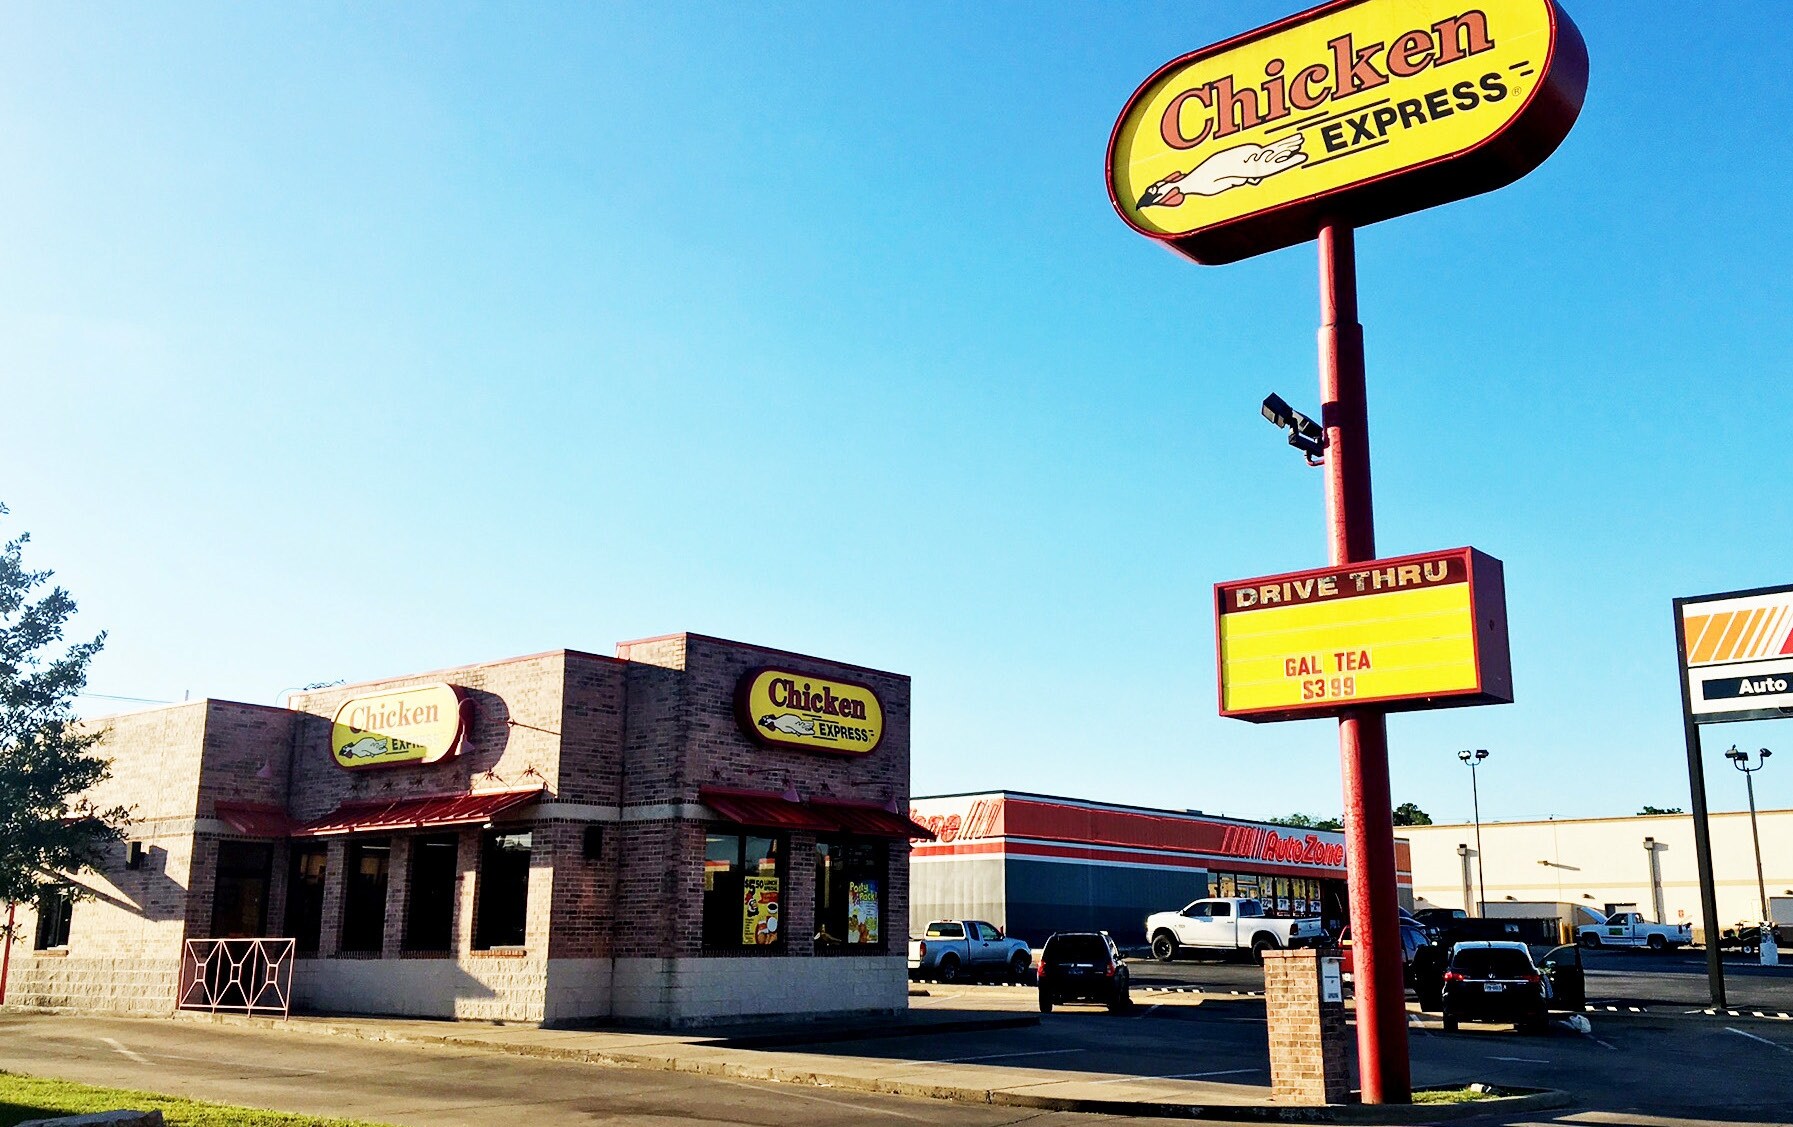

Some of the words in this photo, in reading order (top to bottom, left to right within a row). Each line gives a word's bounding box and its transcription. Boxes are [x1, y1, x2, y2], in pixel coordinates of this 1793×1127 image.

[1160, 9, 1495, 151] Chicken
[1320, 72, 1508, 153] EXPRESS
[1236, 576, 1339, 608] DRIVE
[1349, 560, 1448, 592] THRU
[1285, 656, 1322, 677] GAL
[1334, 650, 1371, 672] TEA
[768, 678, 866, 720] Chicken
[1739, 678, 1787, 695] Auto
[350, 700, 439, 733] Chicken
[819, 723, 868, 742] EXPRESS
[1262, 831, 1344, 867] AutoZone
